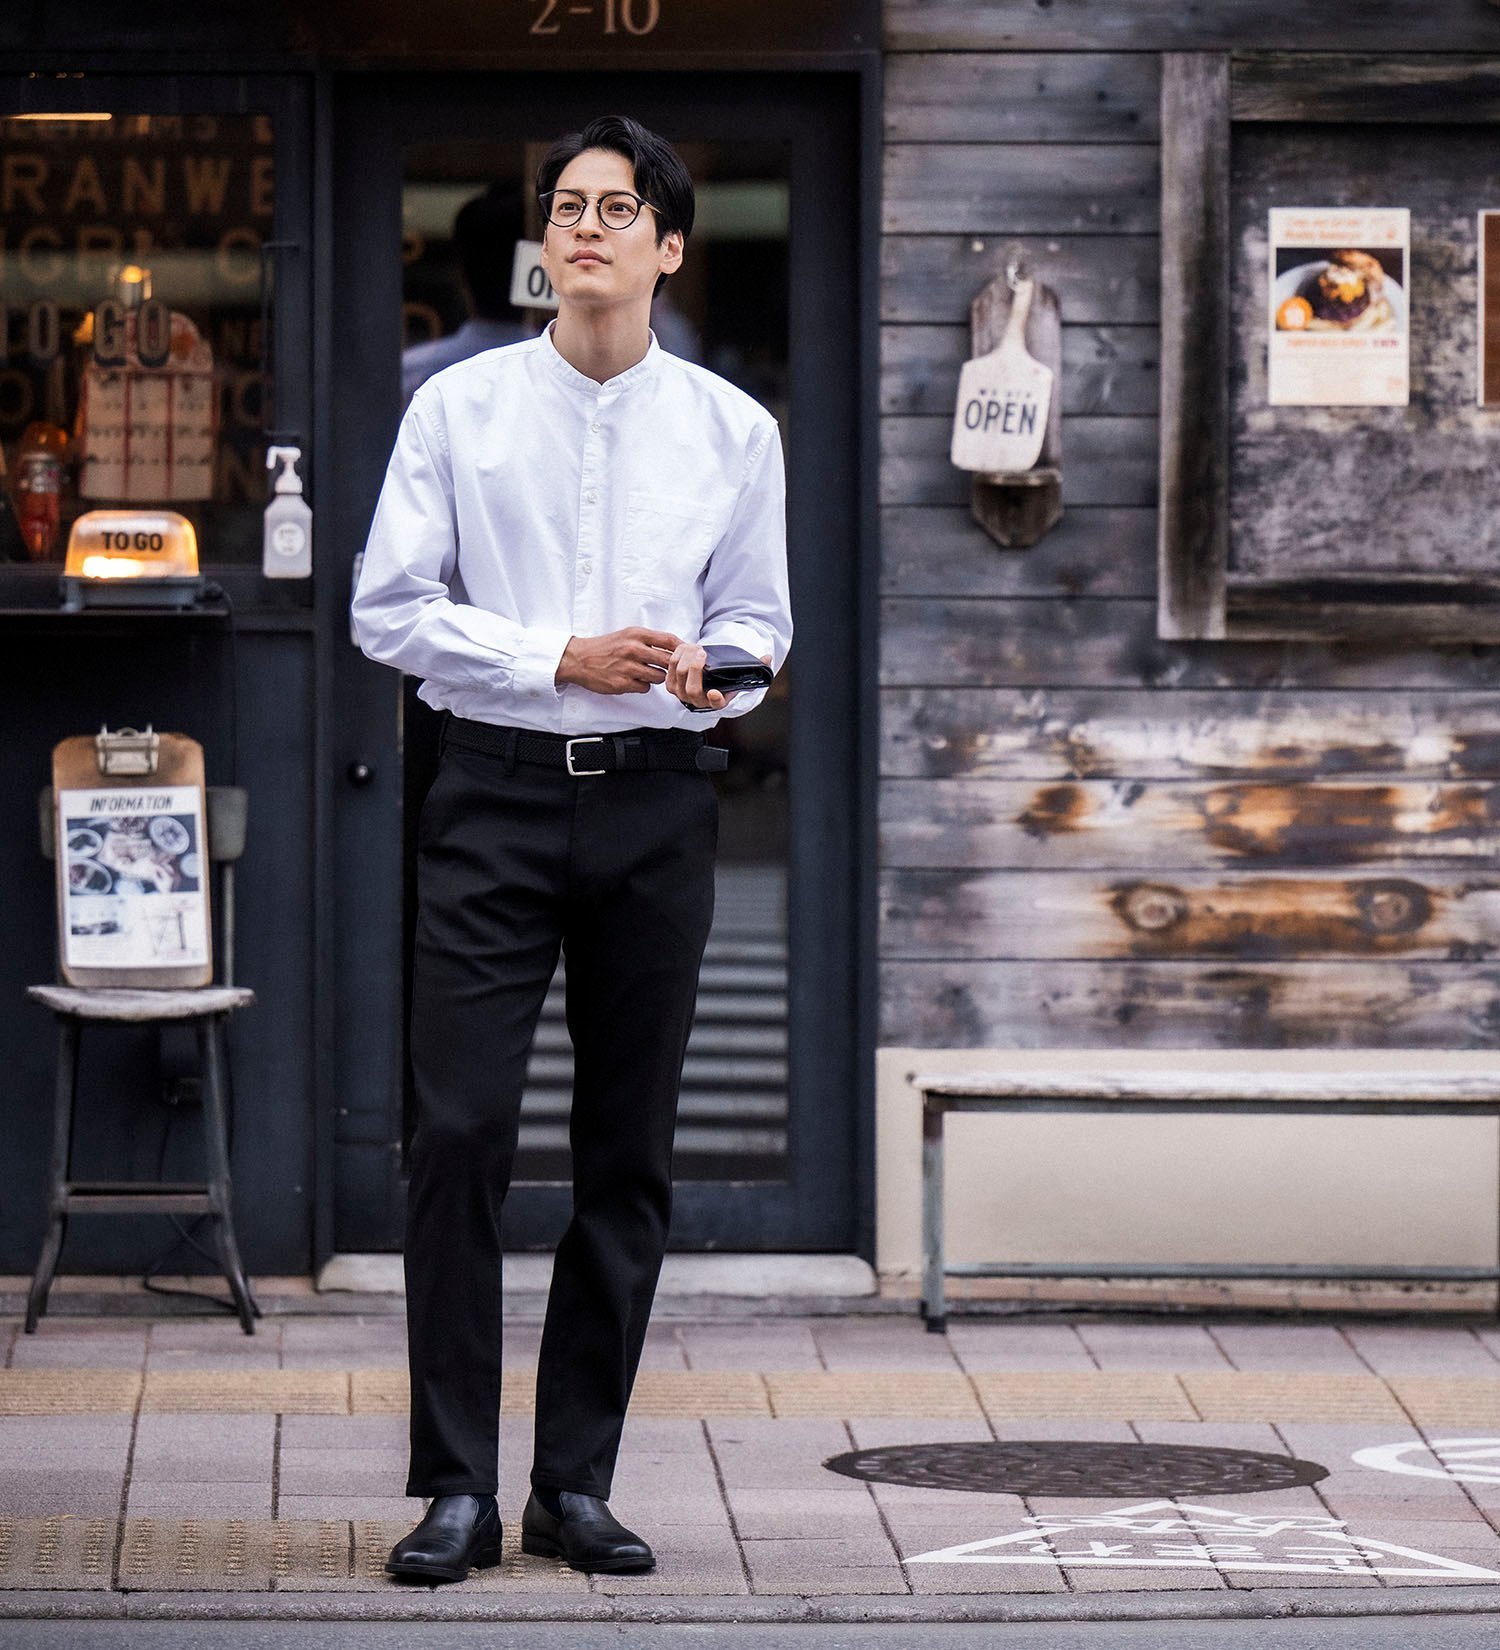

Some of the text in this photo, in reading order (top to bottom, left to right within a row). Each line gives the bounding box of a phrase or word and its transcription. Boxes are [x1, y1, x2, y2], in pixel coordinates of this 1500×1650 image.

[529, 0, 661, 36] 2-10
[528, 265, 552, 299] O
[95, 300, 171, 364] GO
[965, 399, 1037, 435] OPEN
[101, 532, 163, 551] TO GO
[90, 795, 174, 812] INFORMATION
[1016, 1541, 1384, 1565] とまれ
